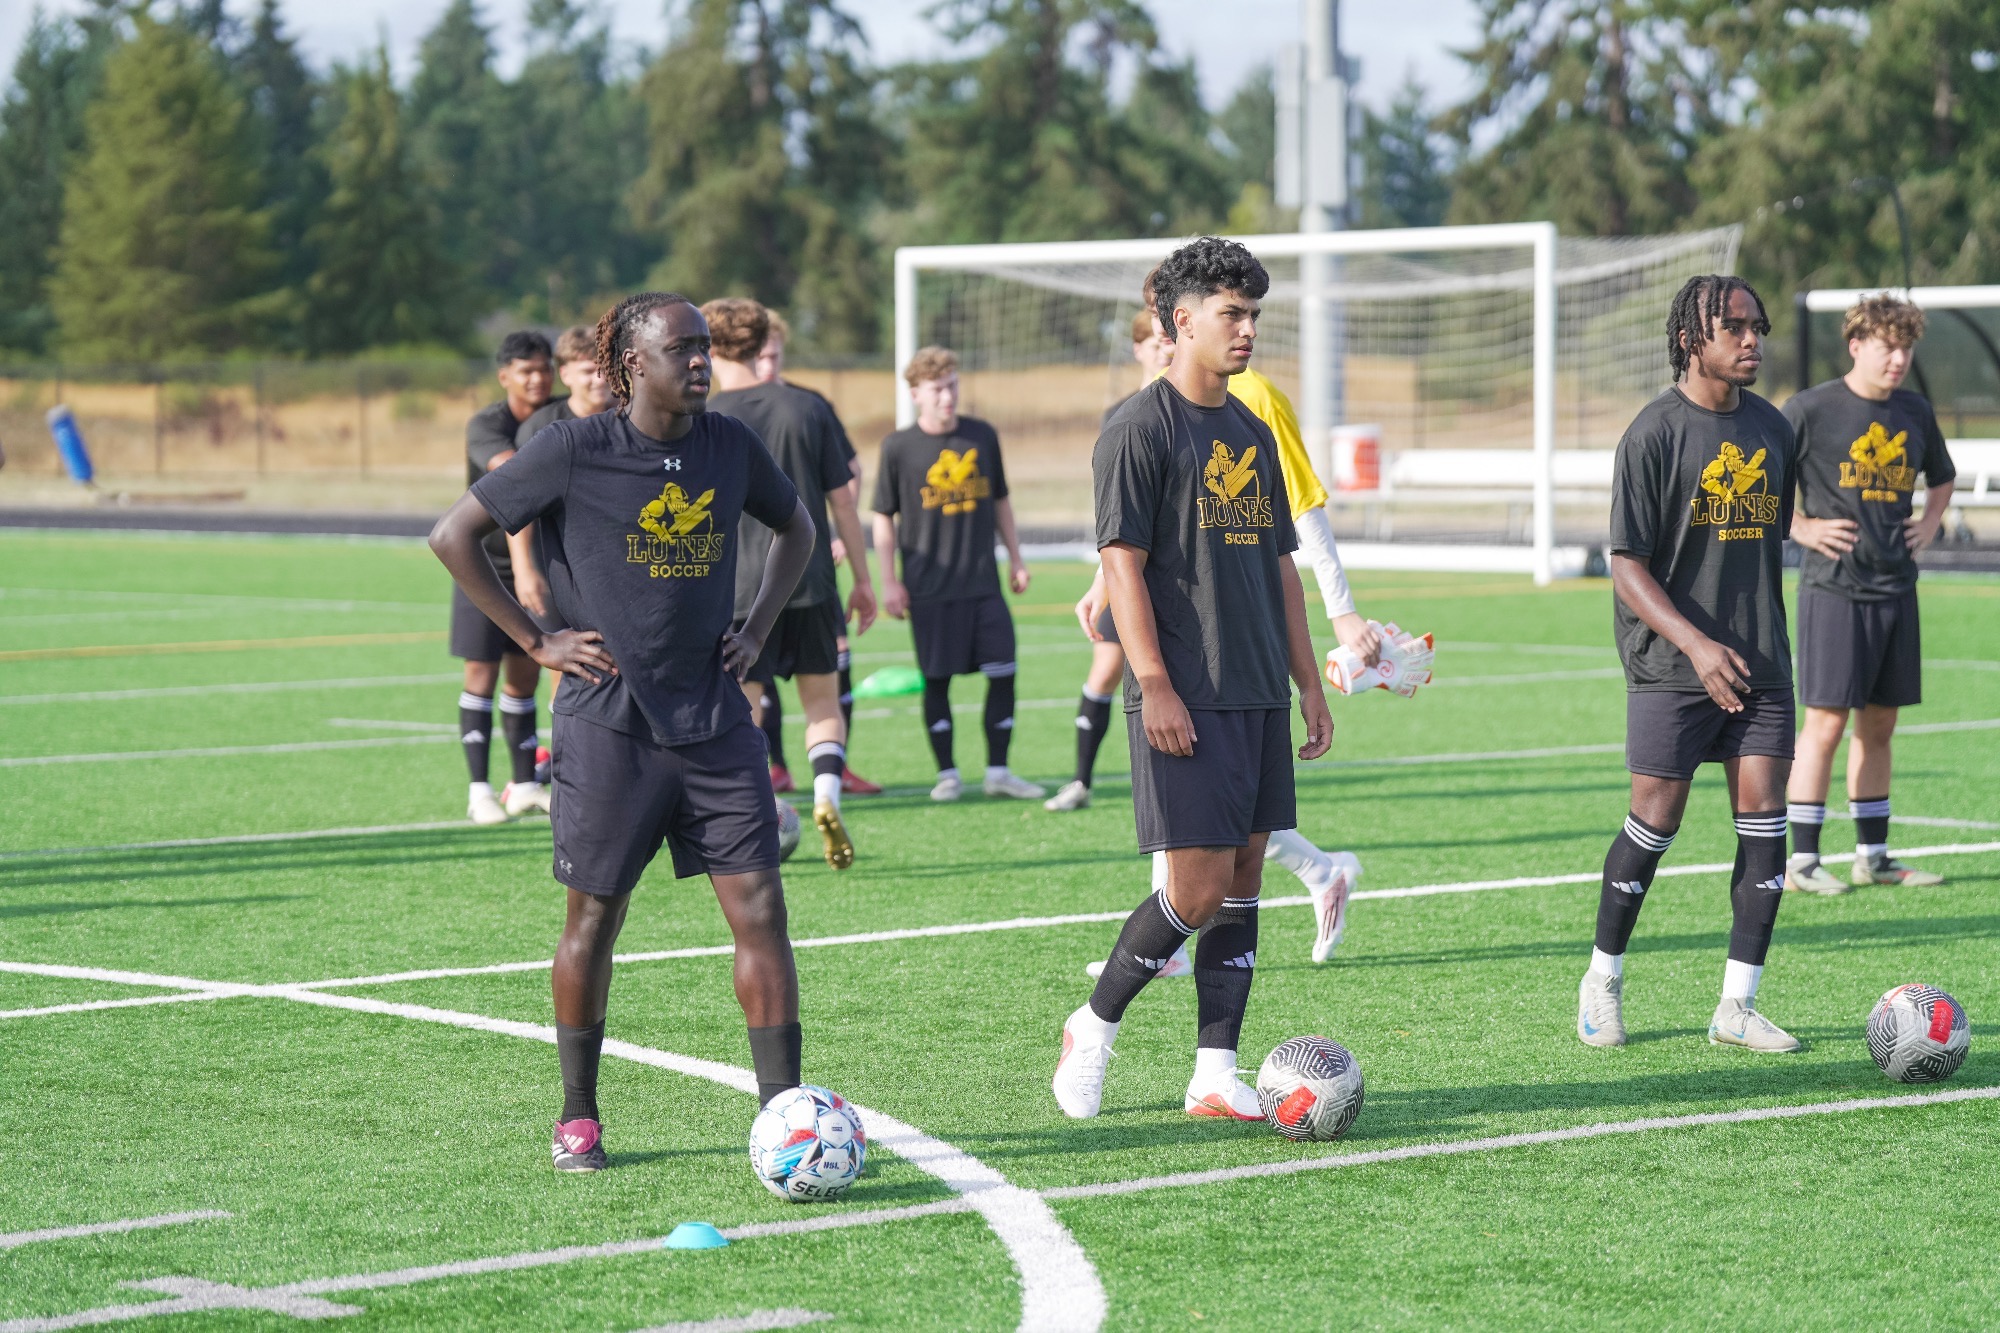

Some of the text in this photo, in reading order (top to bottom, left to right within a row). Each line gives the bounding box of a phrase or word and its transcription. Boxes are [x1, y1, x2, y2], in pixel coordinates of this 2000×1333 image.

[1197, 496, 1274, 528] LUTES
[1690, 493, 1779, 527] LUTES
[626, 533, 725, 563] LUTES
[1718, 528, 1763, 541] SOCCER
[649, 565, 710, 578] SOCCER
